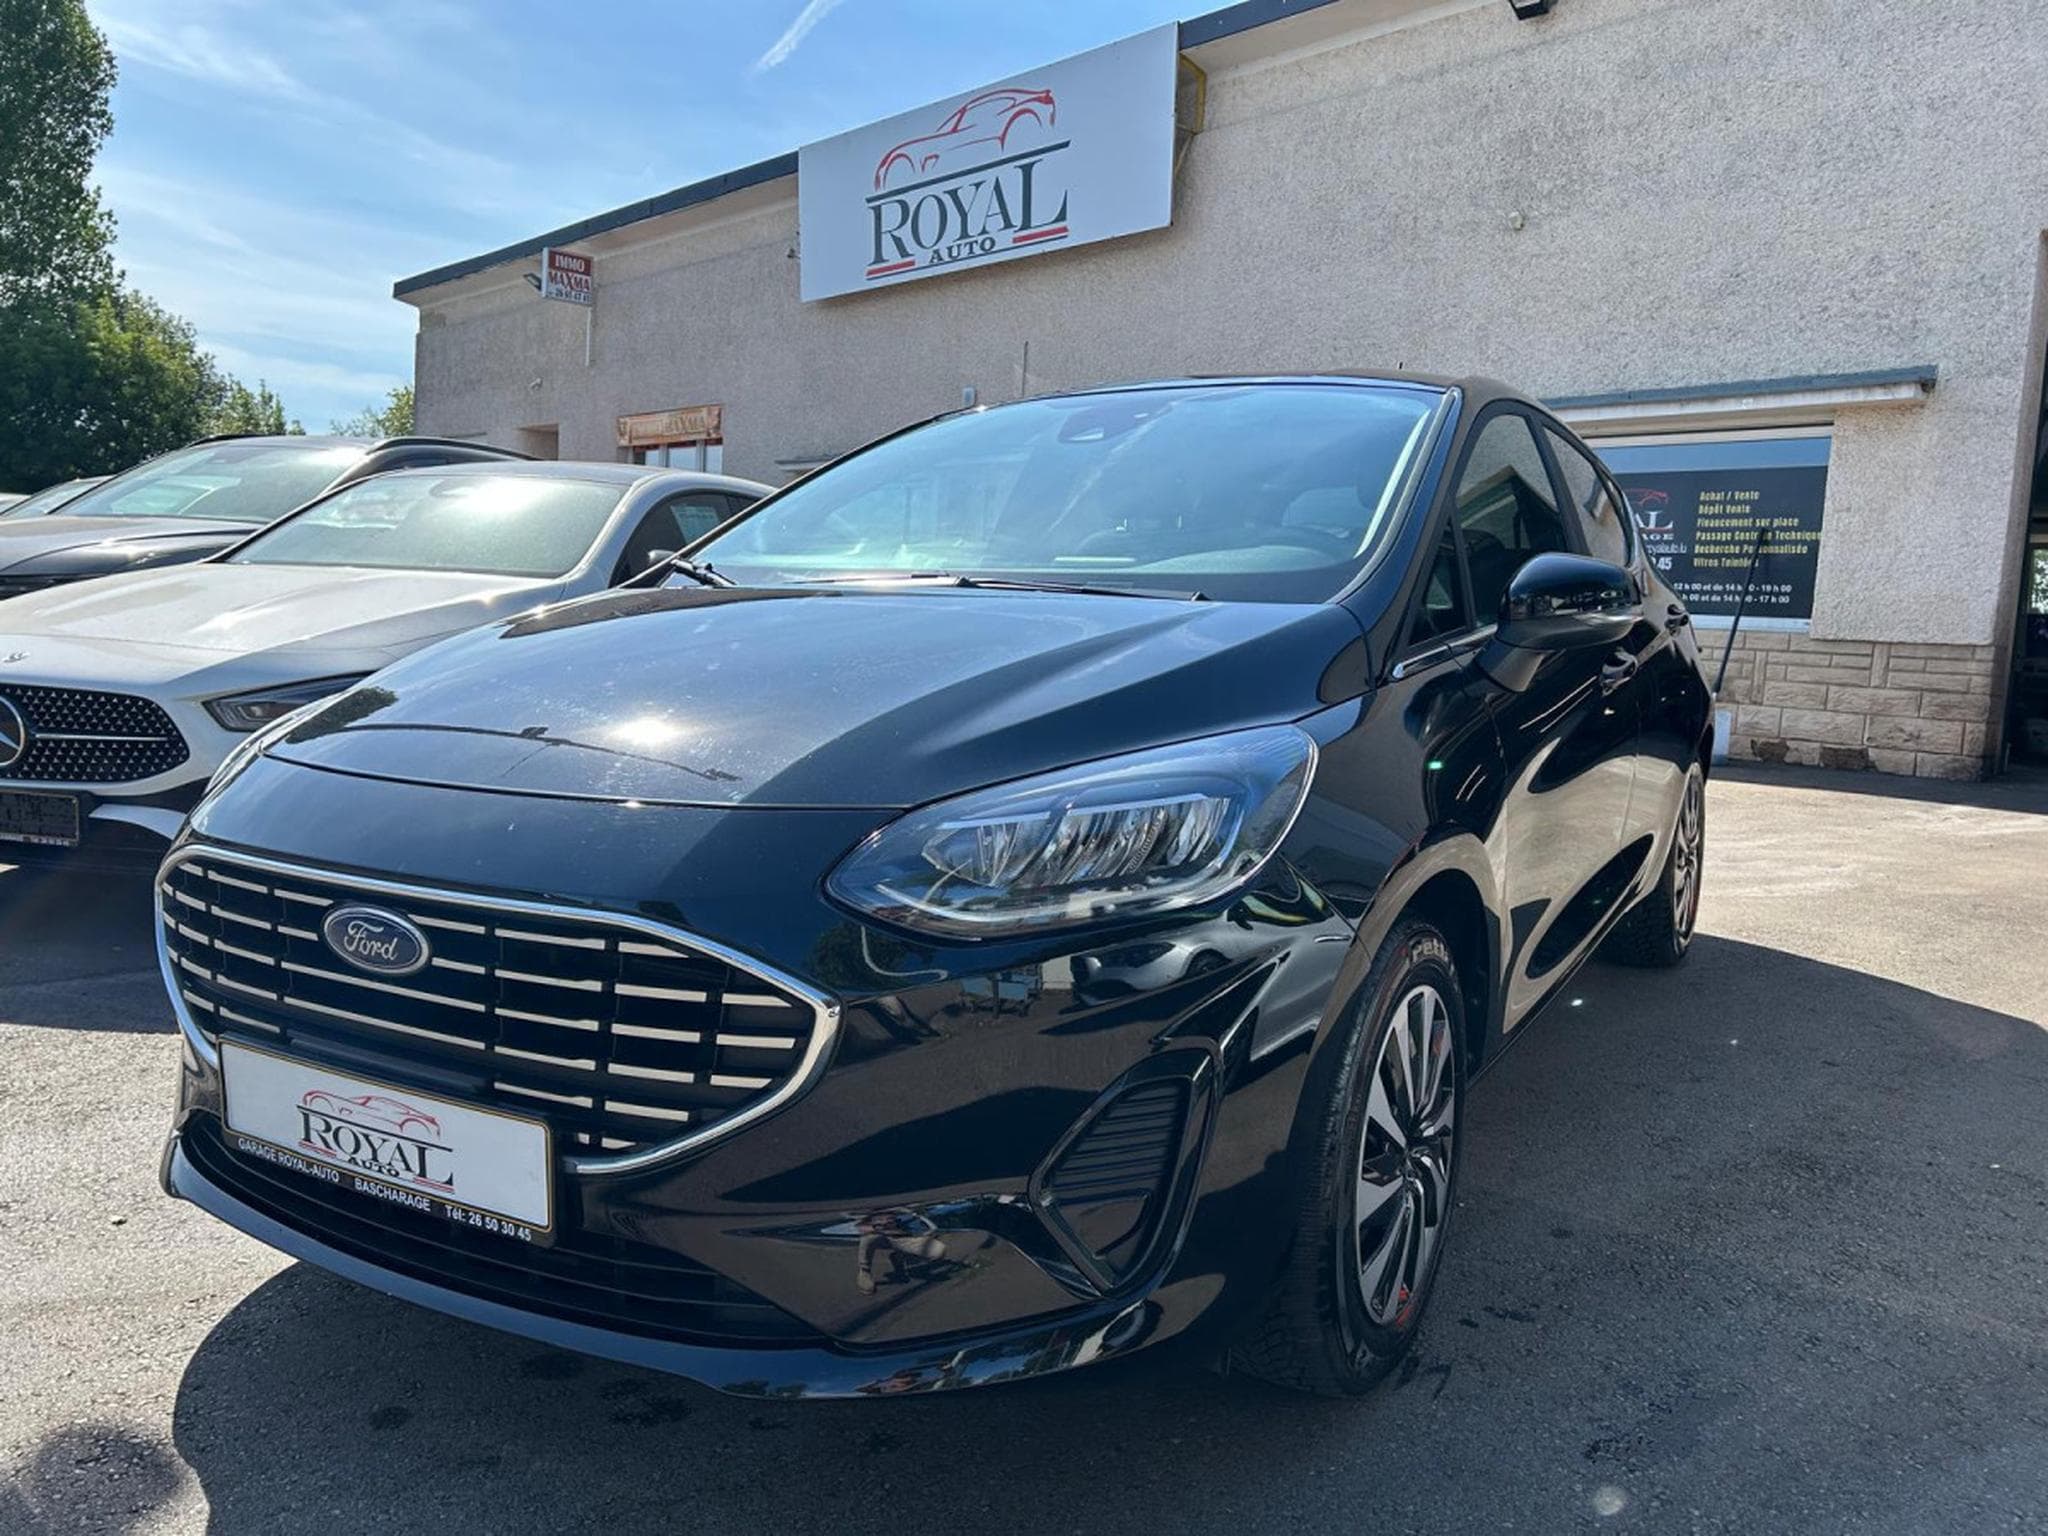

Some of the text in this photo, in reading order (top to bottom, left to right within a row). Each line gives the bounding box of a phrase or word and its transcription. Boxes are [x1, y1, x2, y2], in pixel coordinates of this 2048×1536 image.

[867, 158, 1068, 267] ROYAL
[930, 236, 996, 264] AUTO
[554, 254, 586, 273] IMMO
[1700, 491, 1725, 501] Achat
[1734, 490, 1760, 501] Vente
[1698, 504, 1751, 515] Dépôt Vente
[1697, 516, 1799, 528] Financement sur place
[1695, 530, 1732, 542] Passage
[1734, 530, 1773, 541] Contrle
[1694, 543, 1809, 554] Recherche Pesonnalisée
[1693, 557, 1719, 568] Vitres
[343, 920, 399, 961] Ford
[301, 1110, 455, 1187] ROYAL
[347, 1155, 400, 1178] AUTO
[237, 1137, 533, 1242] GARAGE ROYAL-AUTO BASCHARAGE Tél: 26 50 30 45
